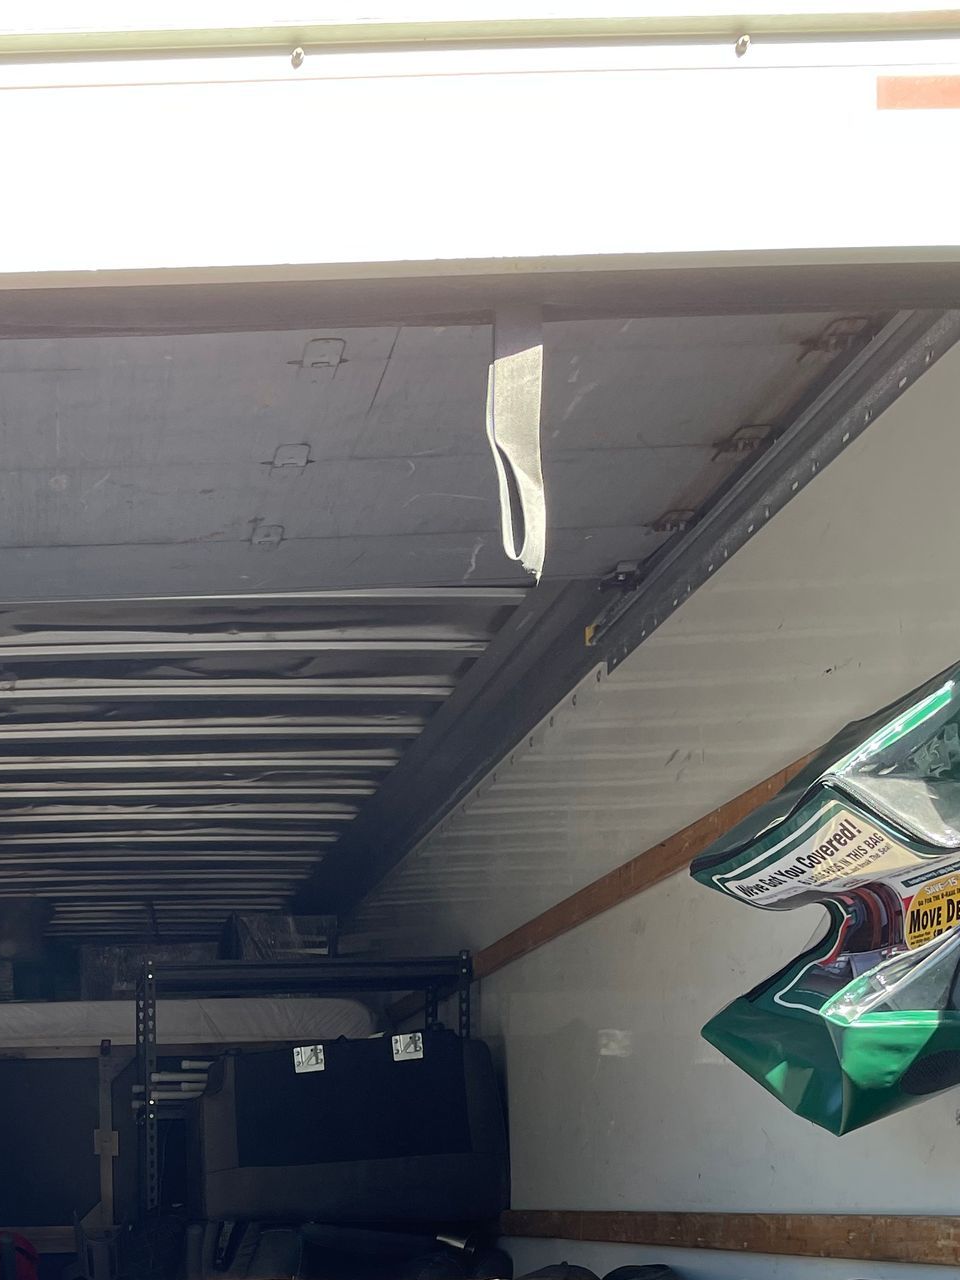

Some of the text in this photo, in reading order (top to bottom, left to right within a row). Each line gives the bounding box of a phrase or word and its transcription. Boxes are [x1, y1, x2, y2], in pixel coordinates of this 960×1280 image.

[758, 873, 784, 889] Got
[773, 865, 807, 884] You
[795, 818, 862, 869] Covered!
[845, 845, 868, 862] THIS
[863, 832, 884, 850] BAG
